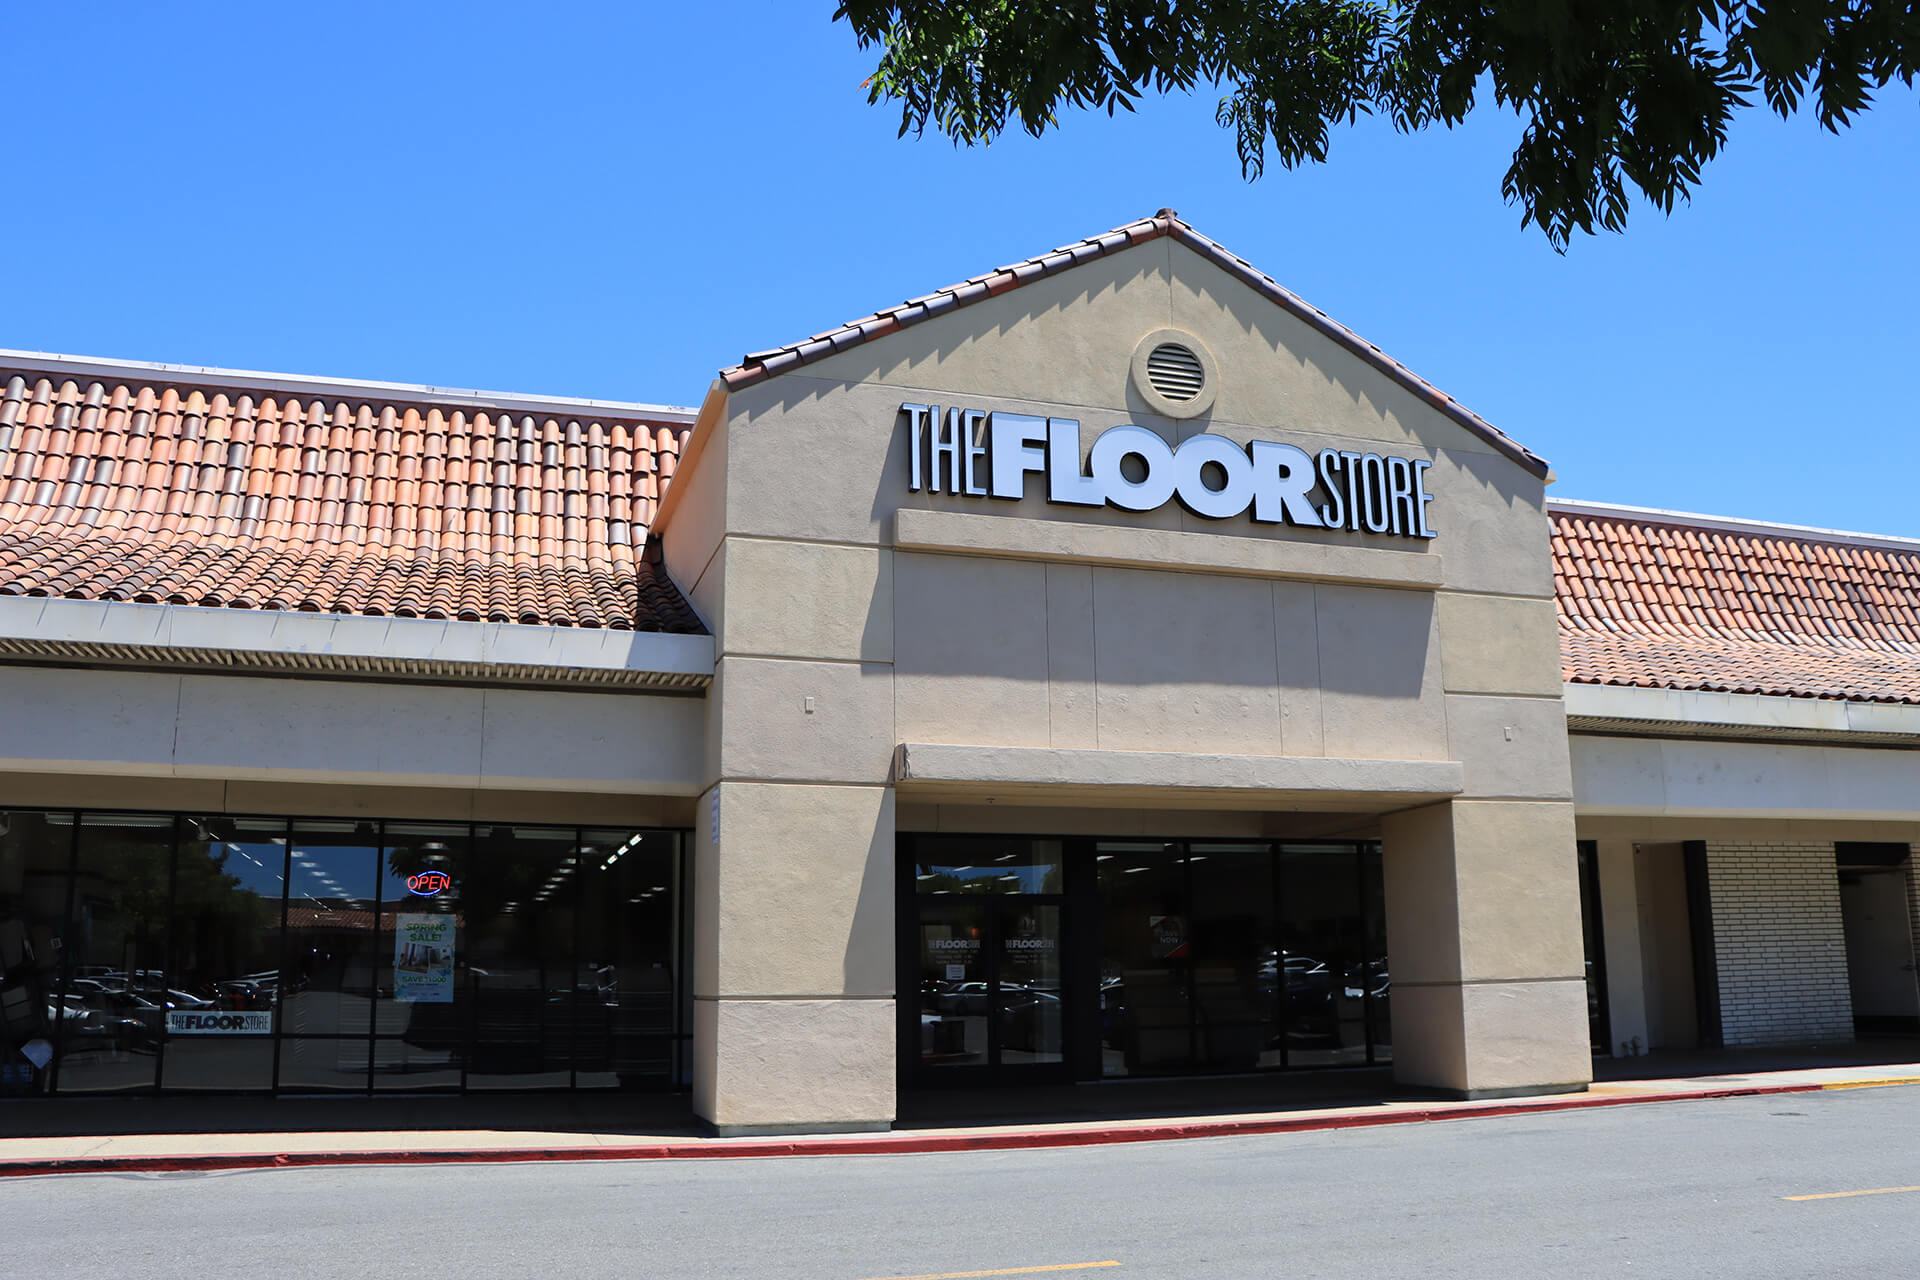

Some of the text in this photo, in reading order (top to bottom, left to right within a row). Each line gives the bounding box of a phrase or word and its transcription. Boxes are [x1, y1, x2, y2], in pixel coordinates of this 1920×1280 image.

[902, 403, 1437, 539] THE FLOOR STORE
[407, 875, 451, 890] OPEN
[405, 922, 447, 932] SPRING
[936, 939, 968, 949] FLOOR
[1013, 939, 1041, 949] FLOOR
[171, 1015, 269, 1031] THE FLOOR STORE
